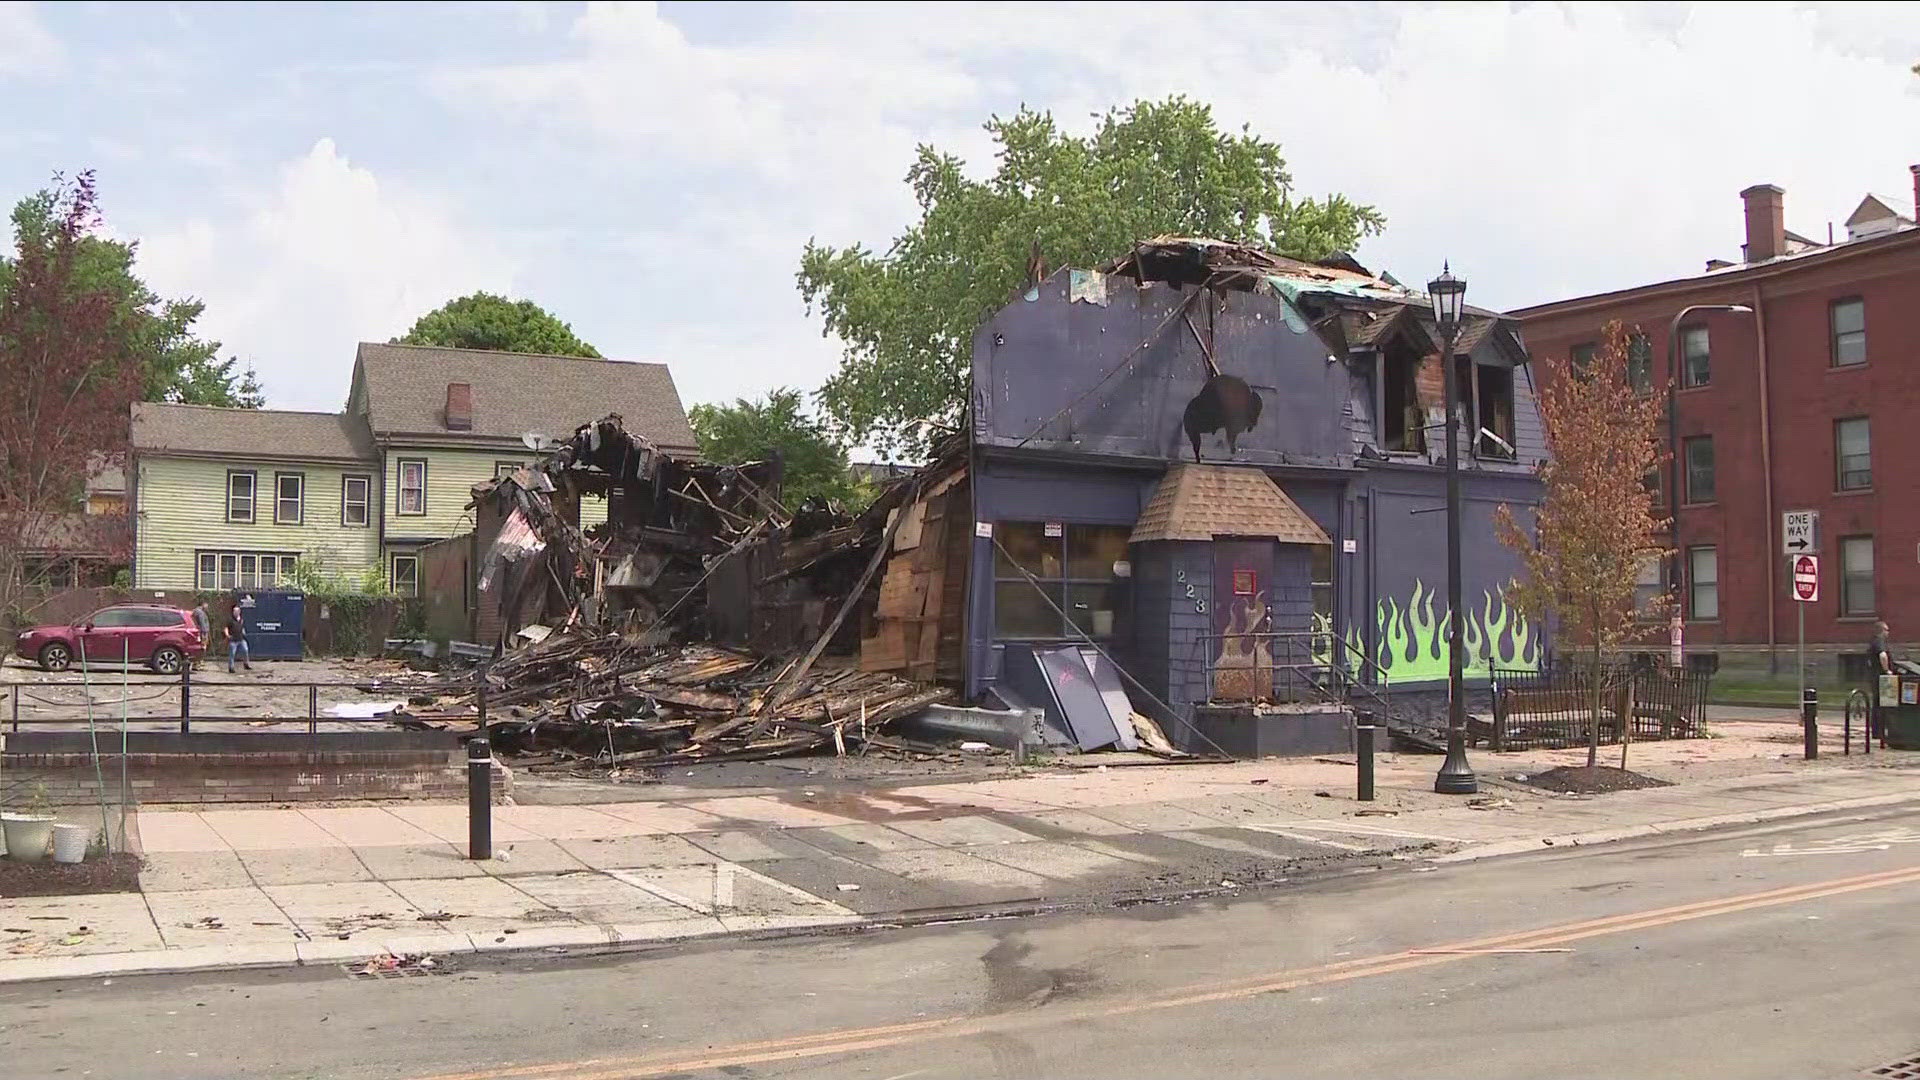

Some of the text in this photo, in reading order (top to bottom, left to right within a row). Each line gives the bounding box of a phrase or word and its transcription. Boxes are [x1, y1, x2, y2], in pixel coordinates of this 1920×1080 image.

[1788, 514, 1808, 525] ONE
[1787, 526, 1809, 536] WAY
[1796, 564, 1814, 573] DO NOT
[1798, 584, 1813, 592] ENTER
